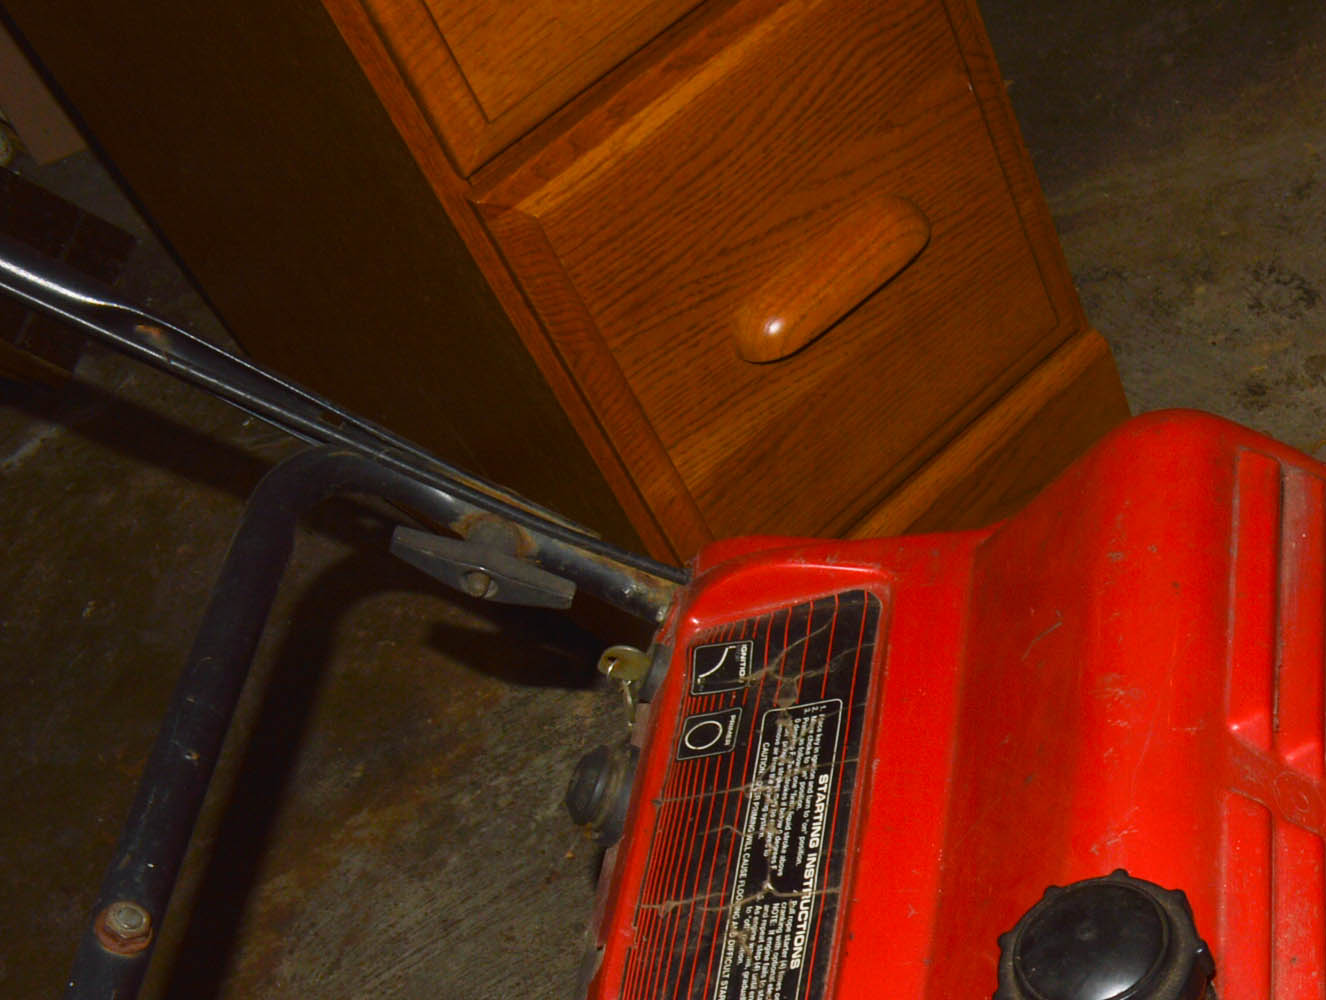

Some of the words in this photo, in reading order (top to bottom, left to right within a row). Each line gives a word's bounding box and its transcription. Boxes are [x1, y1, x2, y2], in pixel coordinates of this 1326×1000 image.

[724, 714, 736, 745] PRIMER
[808, 773, 829, 848] STARTING
[739, 852, 750, 878] CAUSE
[789, 853, 816, 969] INSTRUCTIONS
[721, 939, 735, 979] DIFFICULT
